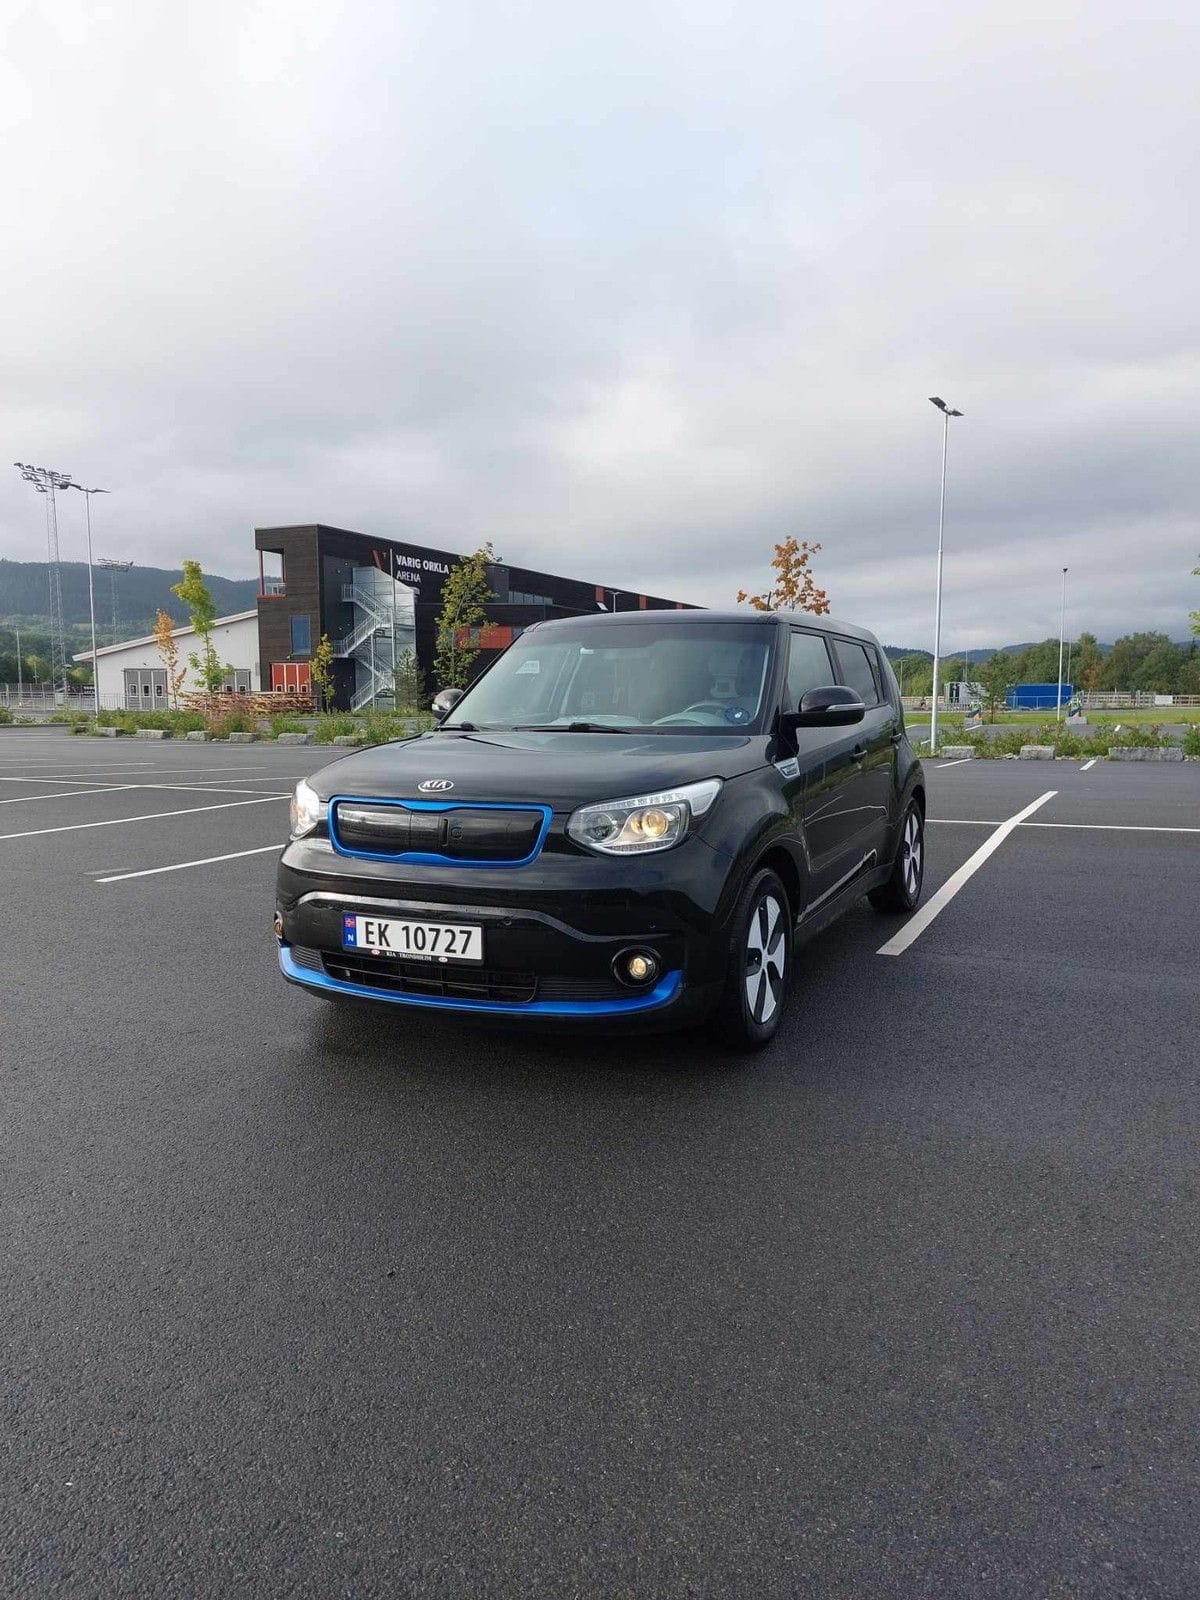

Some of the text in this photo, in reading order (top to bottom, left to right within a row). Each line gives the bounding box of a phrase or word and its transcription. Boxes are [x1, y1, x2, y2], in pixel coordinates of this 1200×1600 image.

[396, 554, 449, 574] VARIG ORKLA
[396, 570, 421, 583] ARENA
[422, 780, 447, 789] KIA
[347, 933, 354, 942] N
[364, 921, 473, 954] EK 10727
